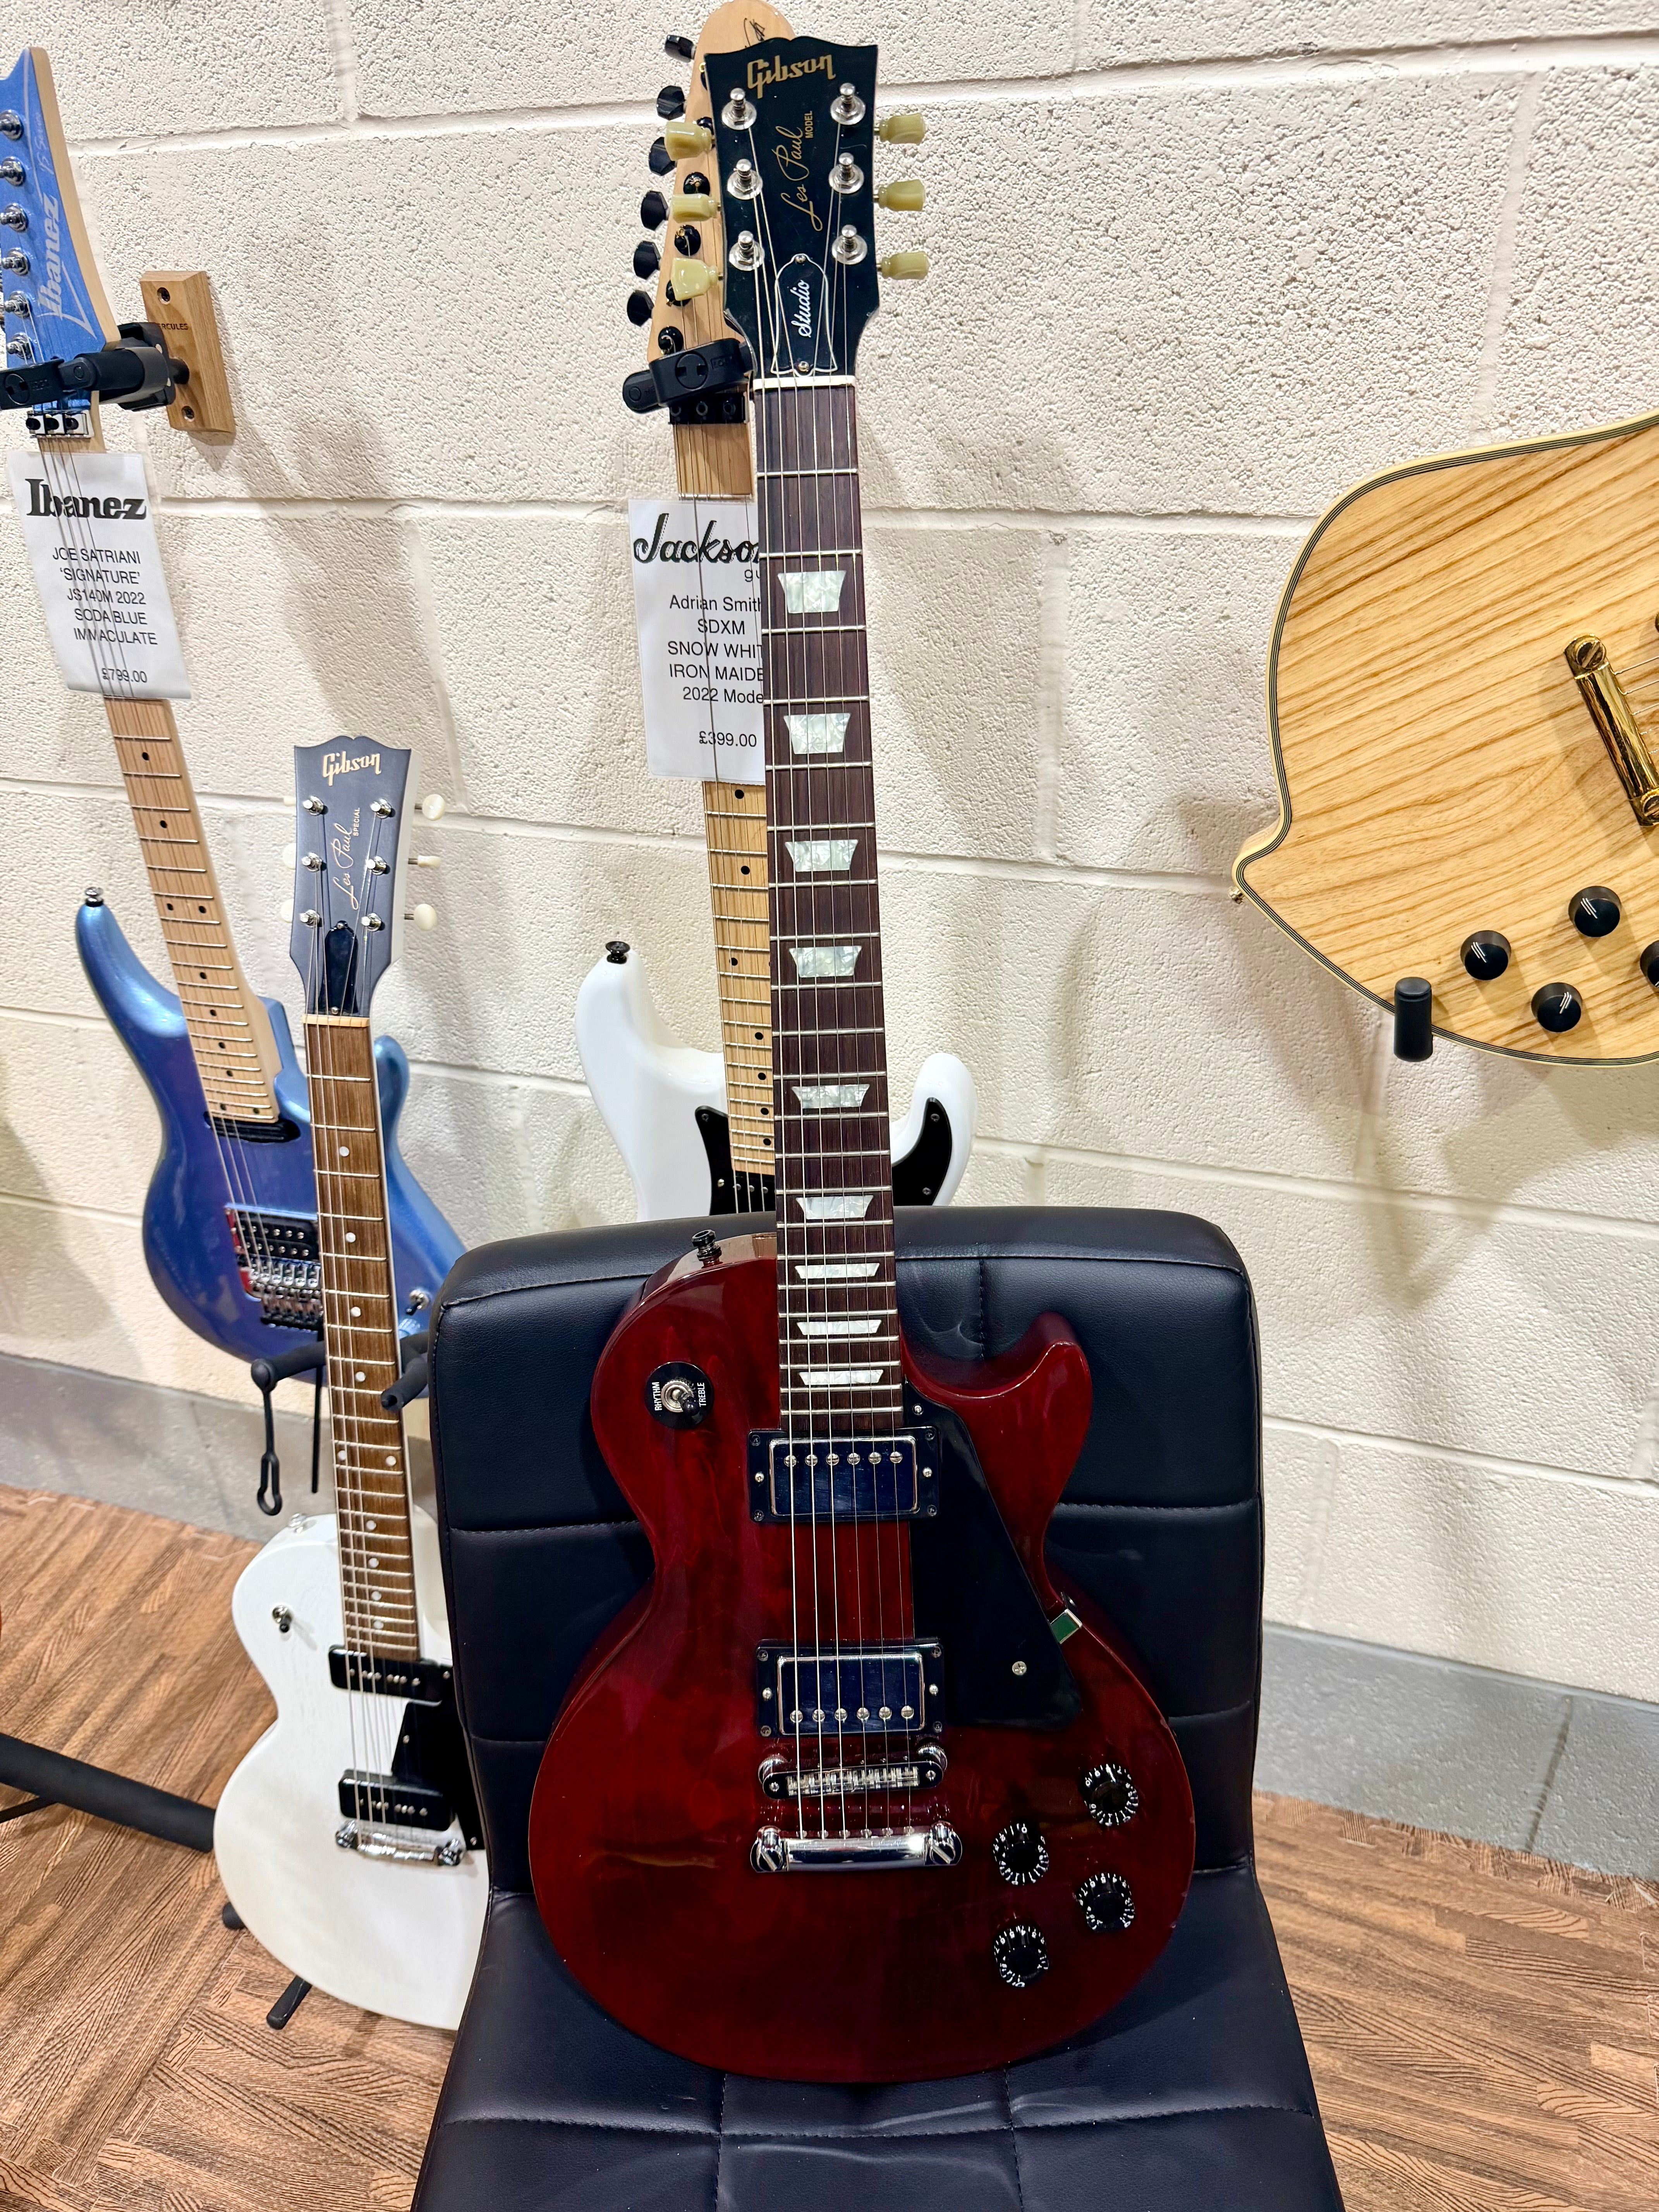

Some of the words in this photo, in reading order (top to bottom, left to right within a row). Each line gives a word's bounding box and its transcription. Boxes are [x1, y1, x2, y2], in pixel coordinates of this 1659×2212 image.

[747, 54, 836, 99] Gibson
[804, 110, 813, 138] MODEL
[771, 126, 809, 181] Paul
[781, 184, 823, 231] Les
[37, 192, 64, 321] Ibanez
[790, 280, 812, 338] Studio
[25, 478, 146, 520] Ibanez
[53, 547, 78, 560] JOE
[80, 548, 141, 564] SATRIANI
[67, 588, 113, 603] JS140M
[116, 591, 146, 605] 2022
[670, 595, 717, 610] Adrian
[74, 608, 111, 622] SODA
[113, 611, 148, 625] BLUE
[698, 618, 745, 635] SDXM
[74, 628, 158, 645] IMMACULATE
[668, 641, 718, 657] SNOW
[101, 668, 147, 683] £799.00
[670, 664, 709, 679] IRON
[683, 687, 718, 702] 2022
[699, 731, 757, 747] £399.00
[323, 751, 381, 786] Gibson
[330, 823, 353, 869] Paul
[333, 872, 359, 910] Les
[652, 1382, 662, 1411] RHYTHM
[697, 1382, 706, 1407] TREBLE
